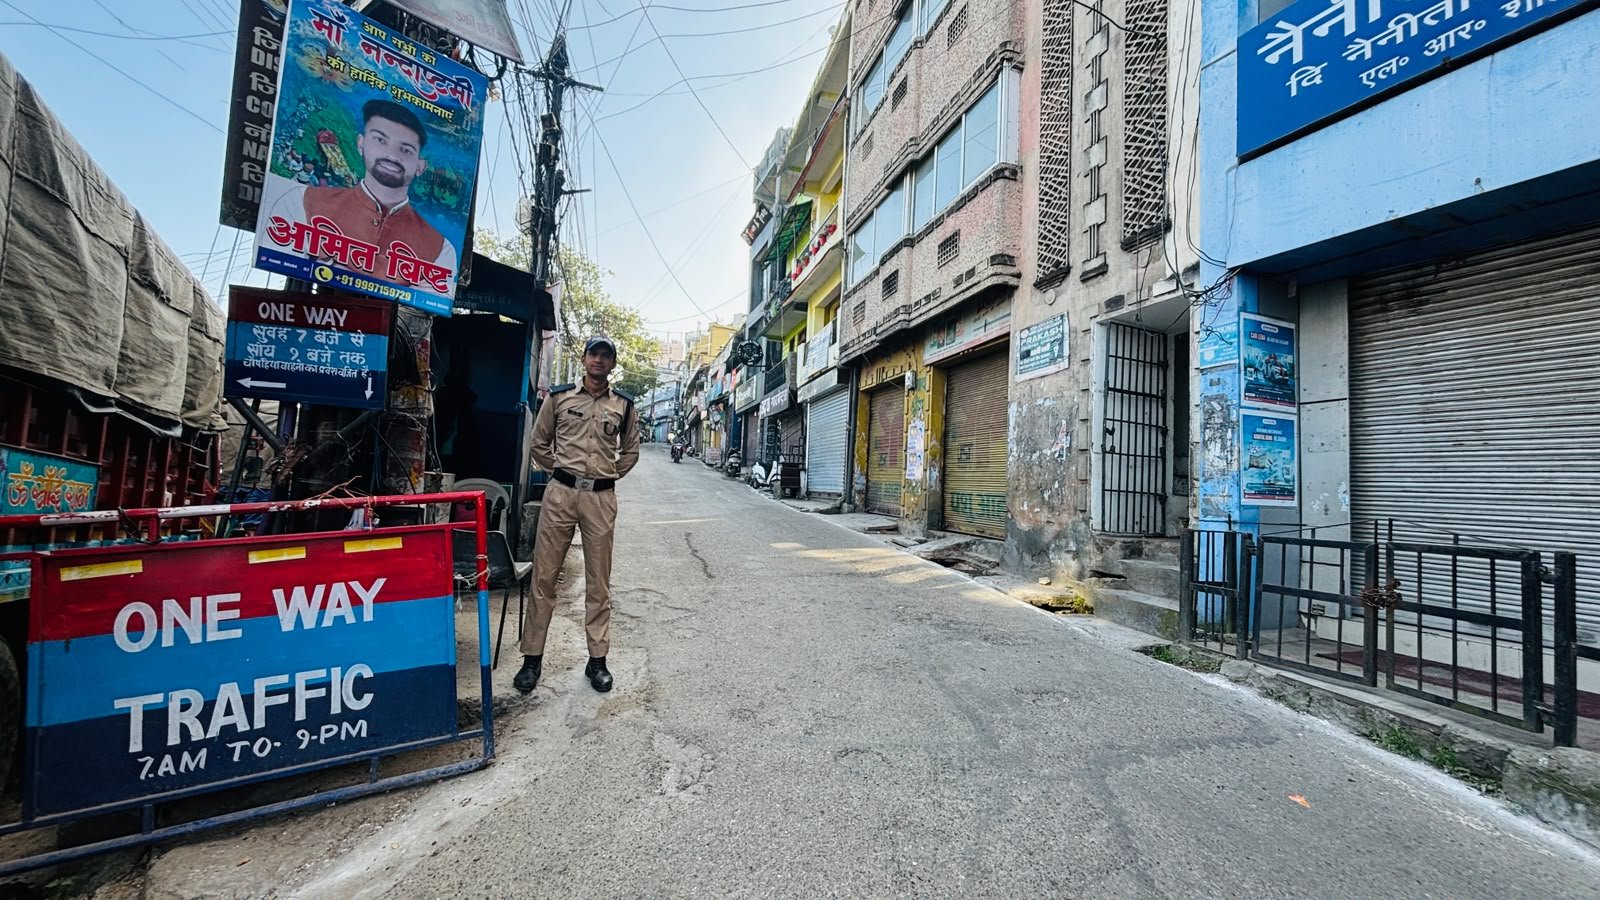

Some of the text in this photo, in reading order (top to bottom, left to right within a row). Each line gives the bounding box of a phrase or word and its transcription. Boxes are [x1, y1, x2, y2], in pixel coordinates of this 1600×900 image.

[307, 7, 350, 51] माँ
[363, 21, 437, 66] आप सभी को
[326, 55, 346, 72] की
[349, 65, 389, 92] हार्दिक
[1285, 62, 1328, 97] दि
[267, 215, 453, 293] अमित बिष्ट
[335, 274, 412, 301] +91 9997159729
[258, 302, 348, 327] ONE WAY
[314, 327, 344, 345] बजे
[349, 329, 366, 347] से
[1021, 325, 1062, 347] PRAKASH
[306, 345, 336, 363] बजे
[339, 351, 366, 365] तक
[113, 578, 387, 653] ONE WAY
[114, 663, 374, 753] TRAFFIC
